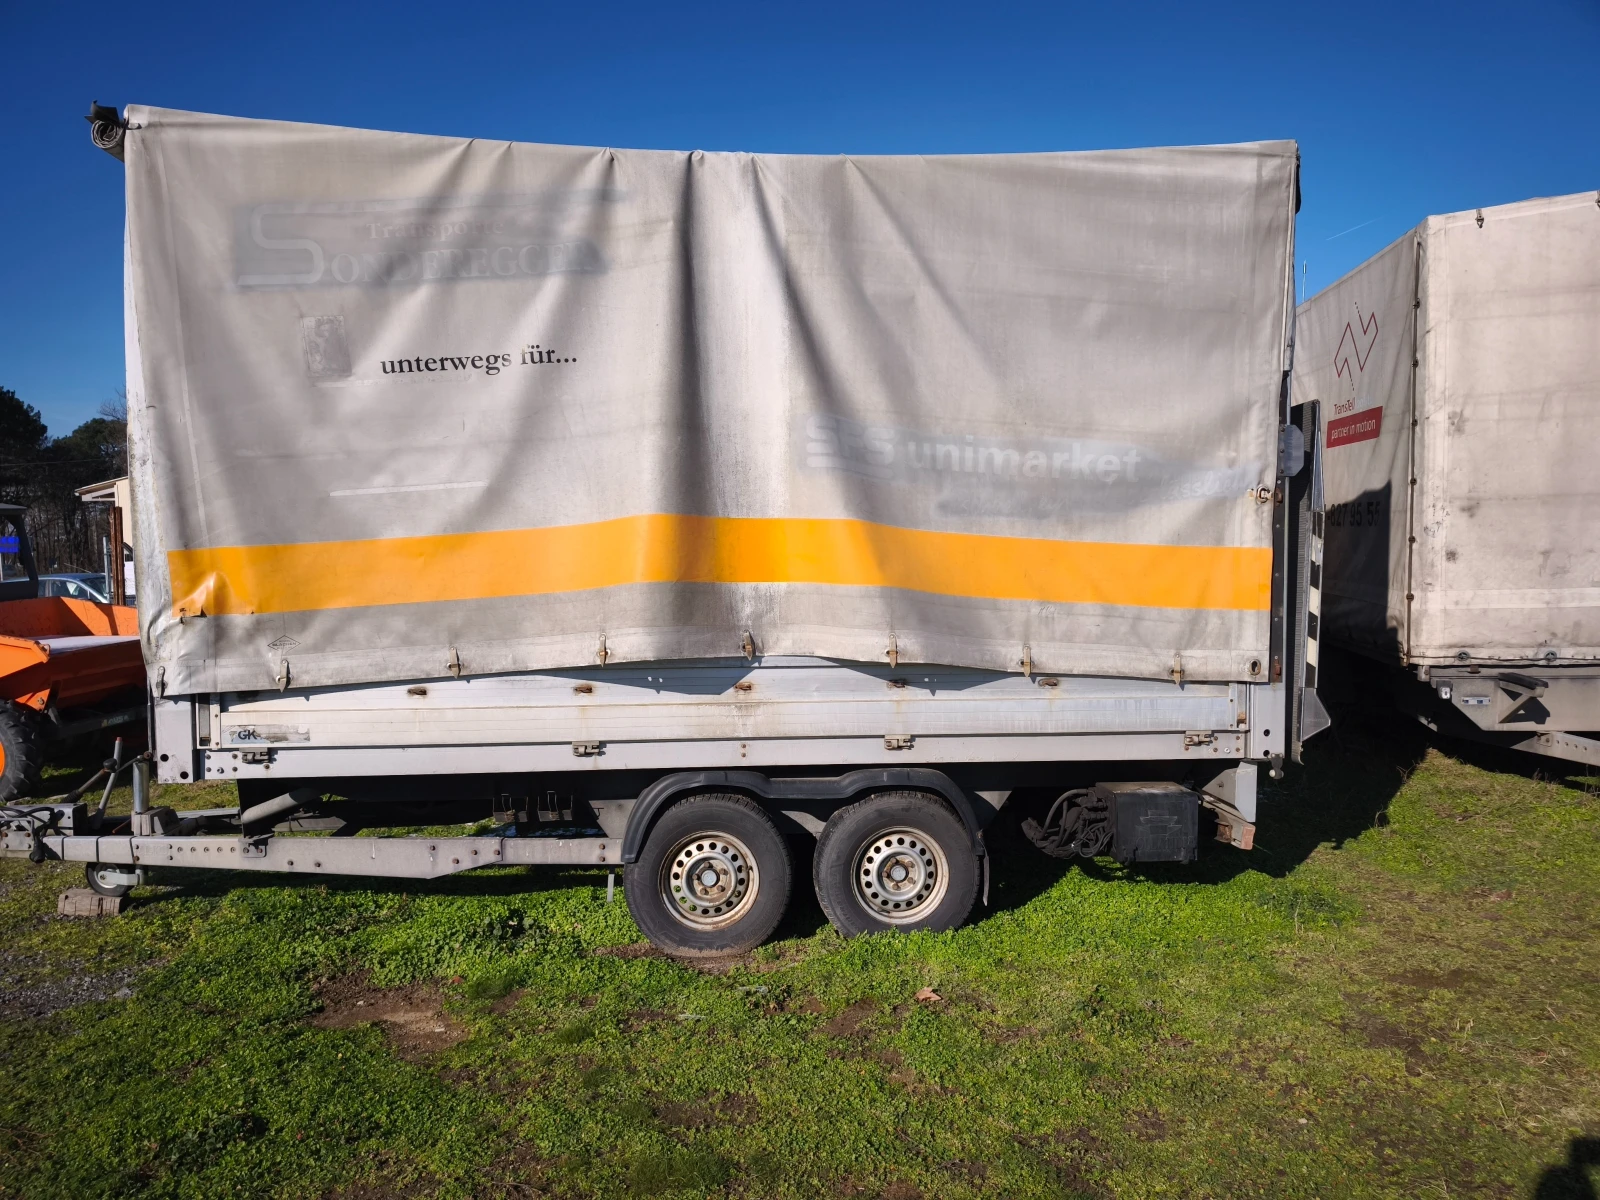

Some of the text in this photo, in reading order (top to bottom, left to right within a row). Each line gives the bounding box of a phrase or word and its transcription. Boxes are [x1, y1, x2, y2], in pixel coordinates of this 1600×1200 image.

[380, 344, 578, 376] unterwegs für...
[1331, 417, 1376, 443] partner in motion
[905, 434, 1142, 484] unimarket
